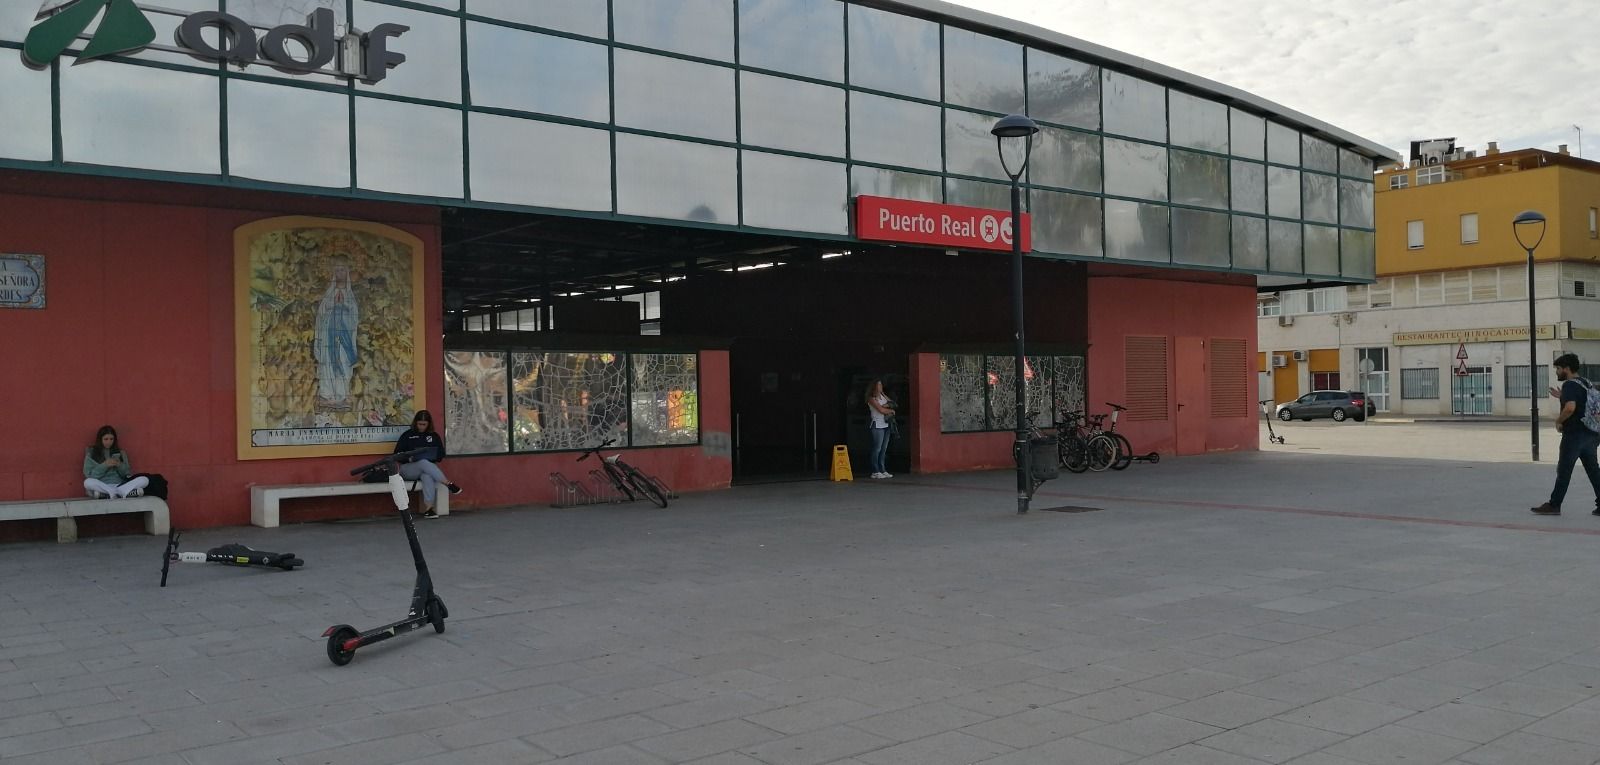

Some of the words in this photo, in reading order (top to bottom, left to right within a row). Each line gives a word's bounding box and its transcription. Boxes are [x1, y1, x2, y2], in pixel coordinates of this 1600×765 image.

[879, 207, 935, 234] Puerto
[941, 214, 976, 238] Real
[0, 274, 35, 287] SEÑORA
[1397, 331, 1456, 341] RESTAURANTE
[1489, 327, 1547, 337] CANTONSE
